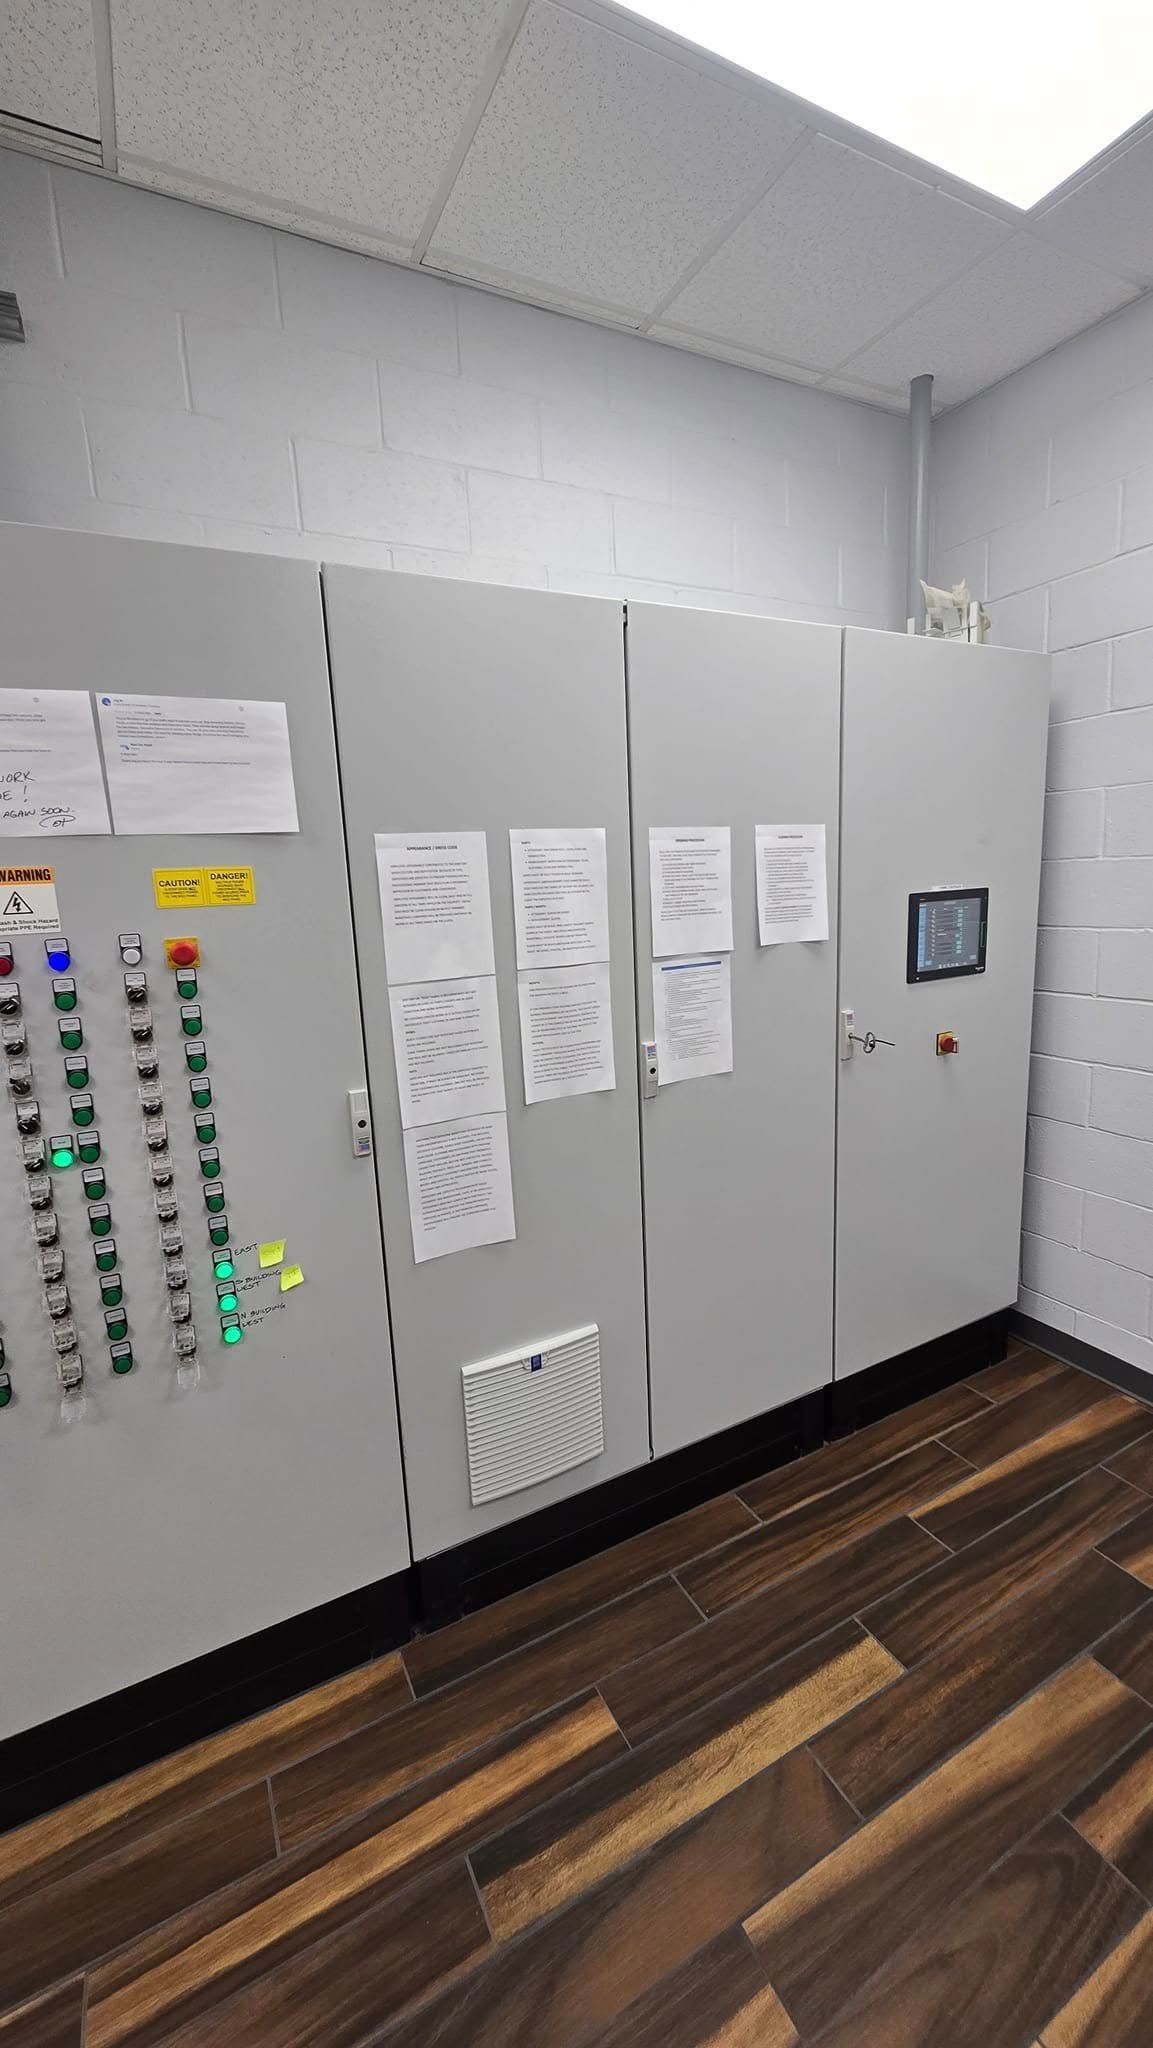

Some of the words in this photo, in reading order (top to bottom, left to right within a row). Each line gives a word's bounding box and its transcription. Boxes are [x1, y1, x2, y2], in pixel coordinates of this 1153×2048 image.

[3, 809, 36, 819] AGAIN
[210, 872, 248, 880] DANGER!
[158, 879, 200, 888] CAUTION!
[234, 1243, 258, 1256] EAST
[250, 1303, 287, 1317] BUILDING
